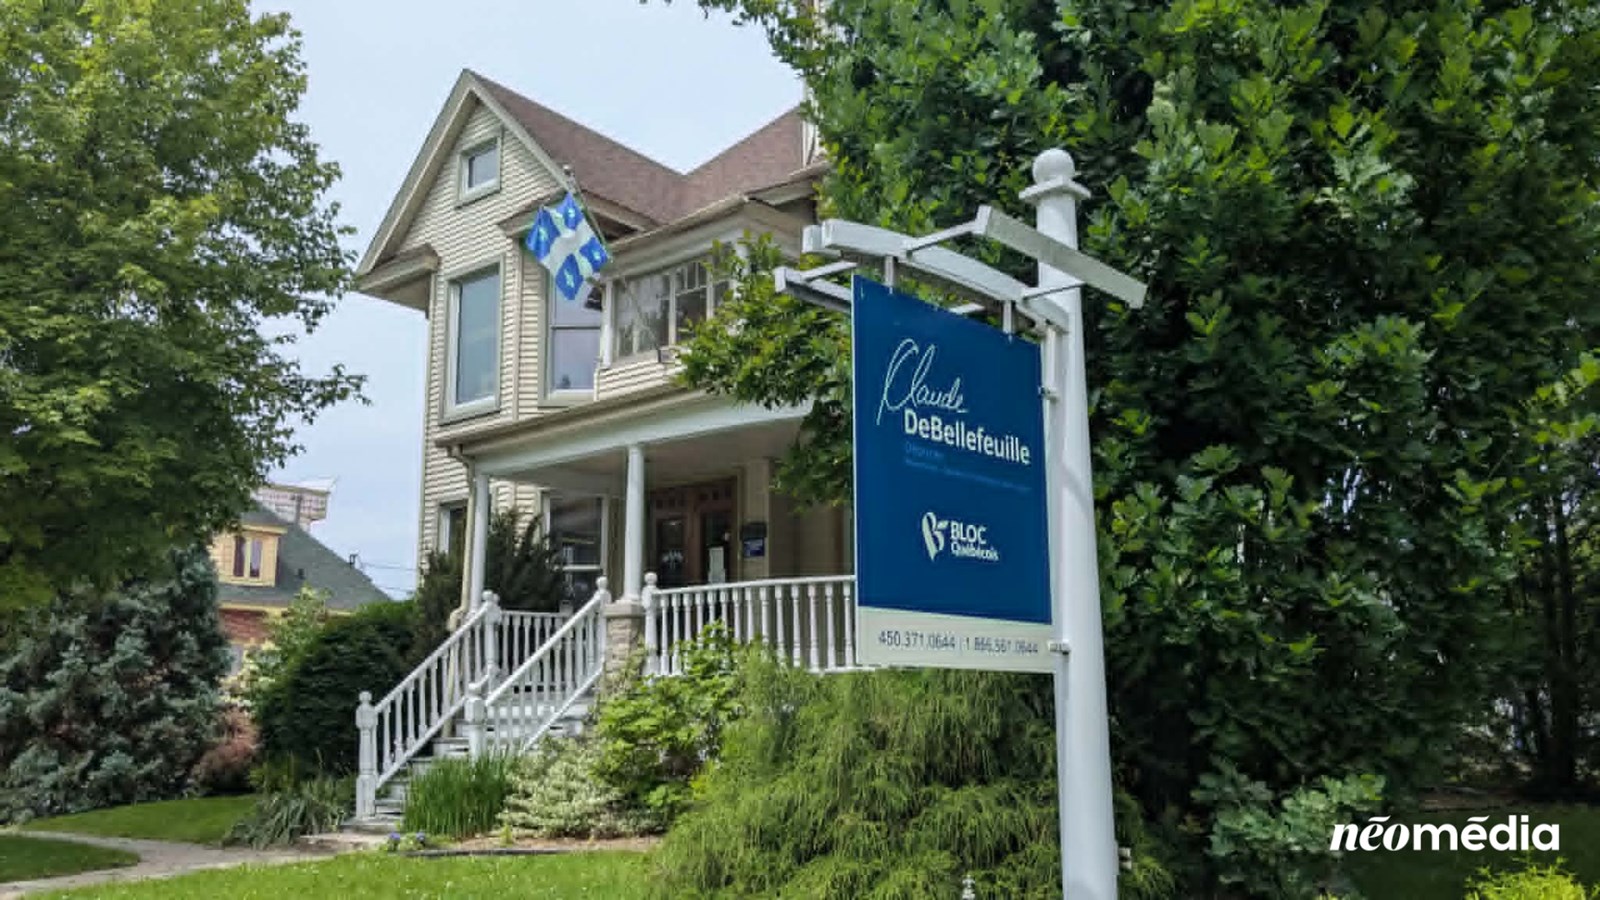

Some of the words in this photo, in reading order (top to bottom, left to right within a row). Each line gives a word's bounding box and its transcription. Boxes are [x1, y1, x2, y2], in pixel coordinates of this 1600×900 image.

[876, 338, 969, 426] Claude
[904, 408, 1031, 465] DeBellefeuille
[950, 520, 987, 545] BLOC
